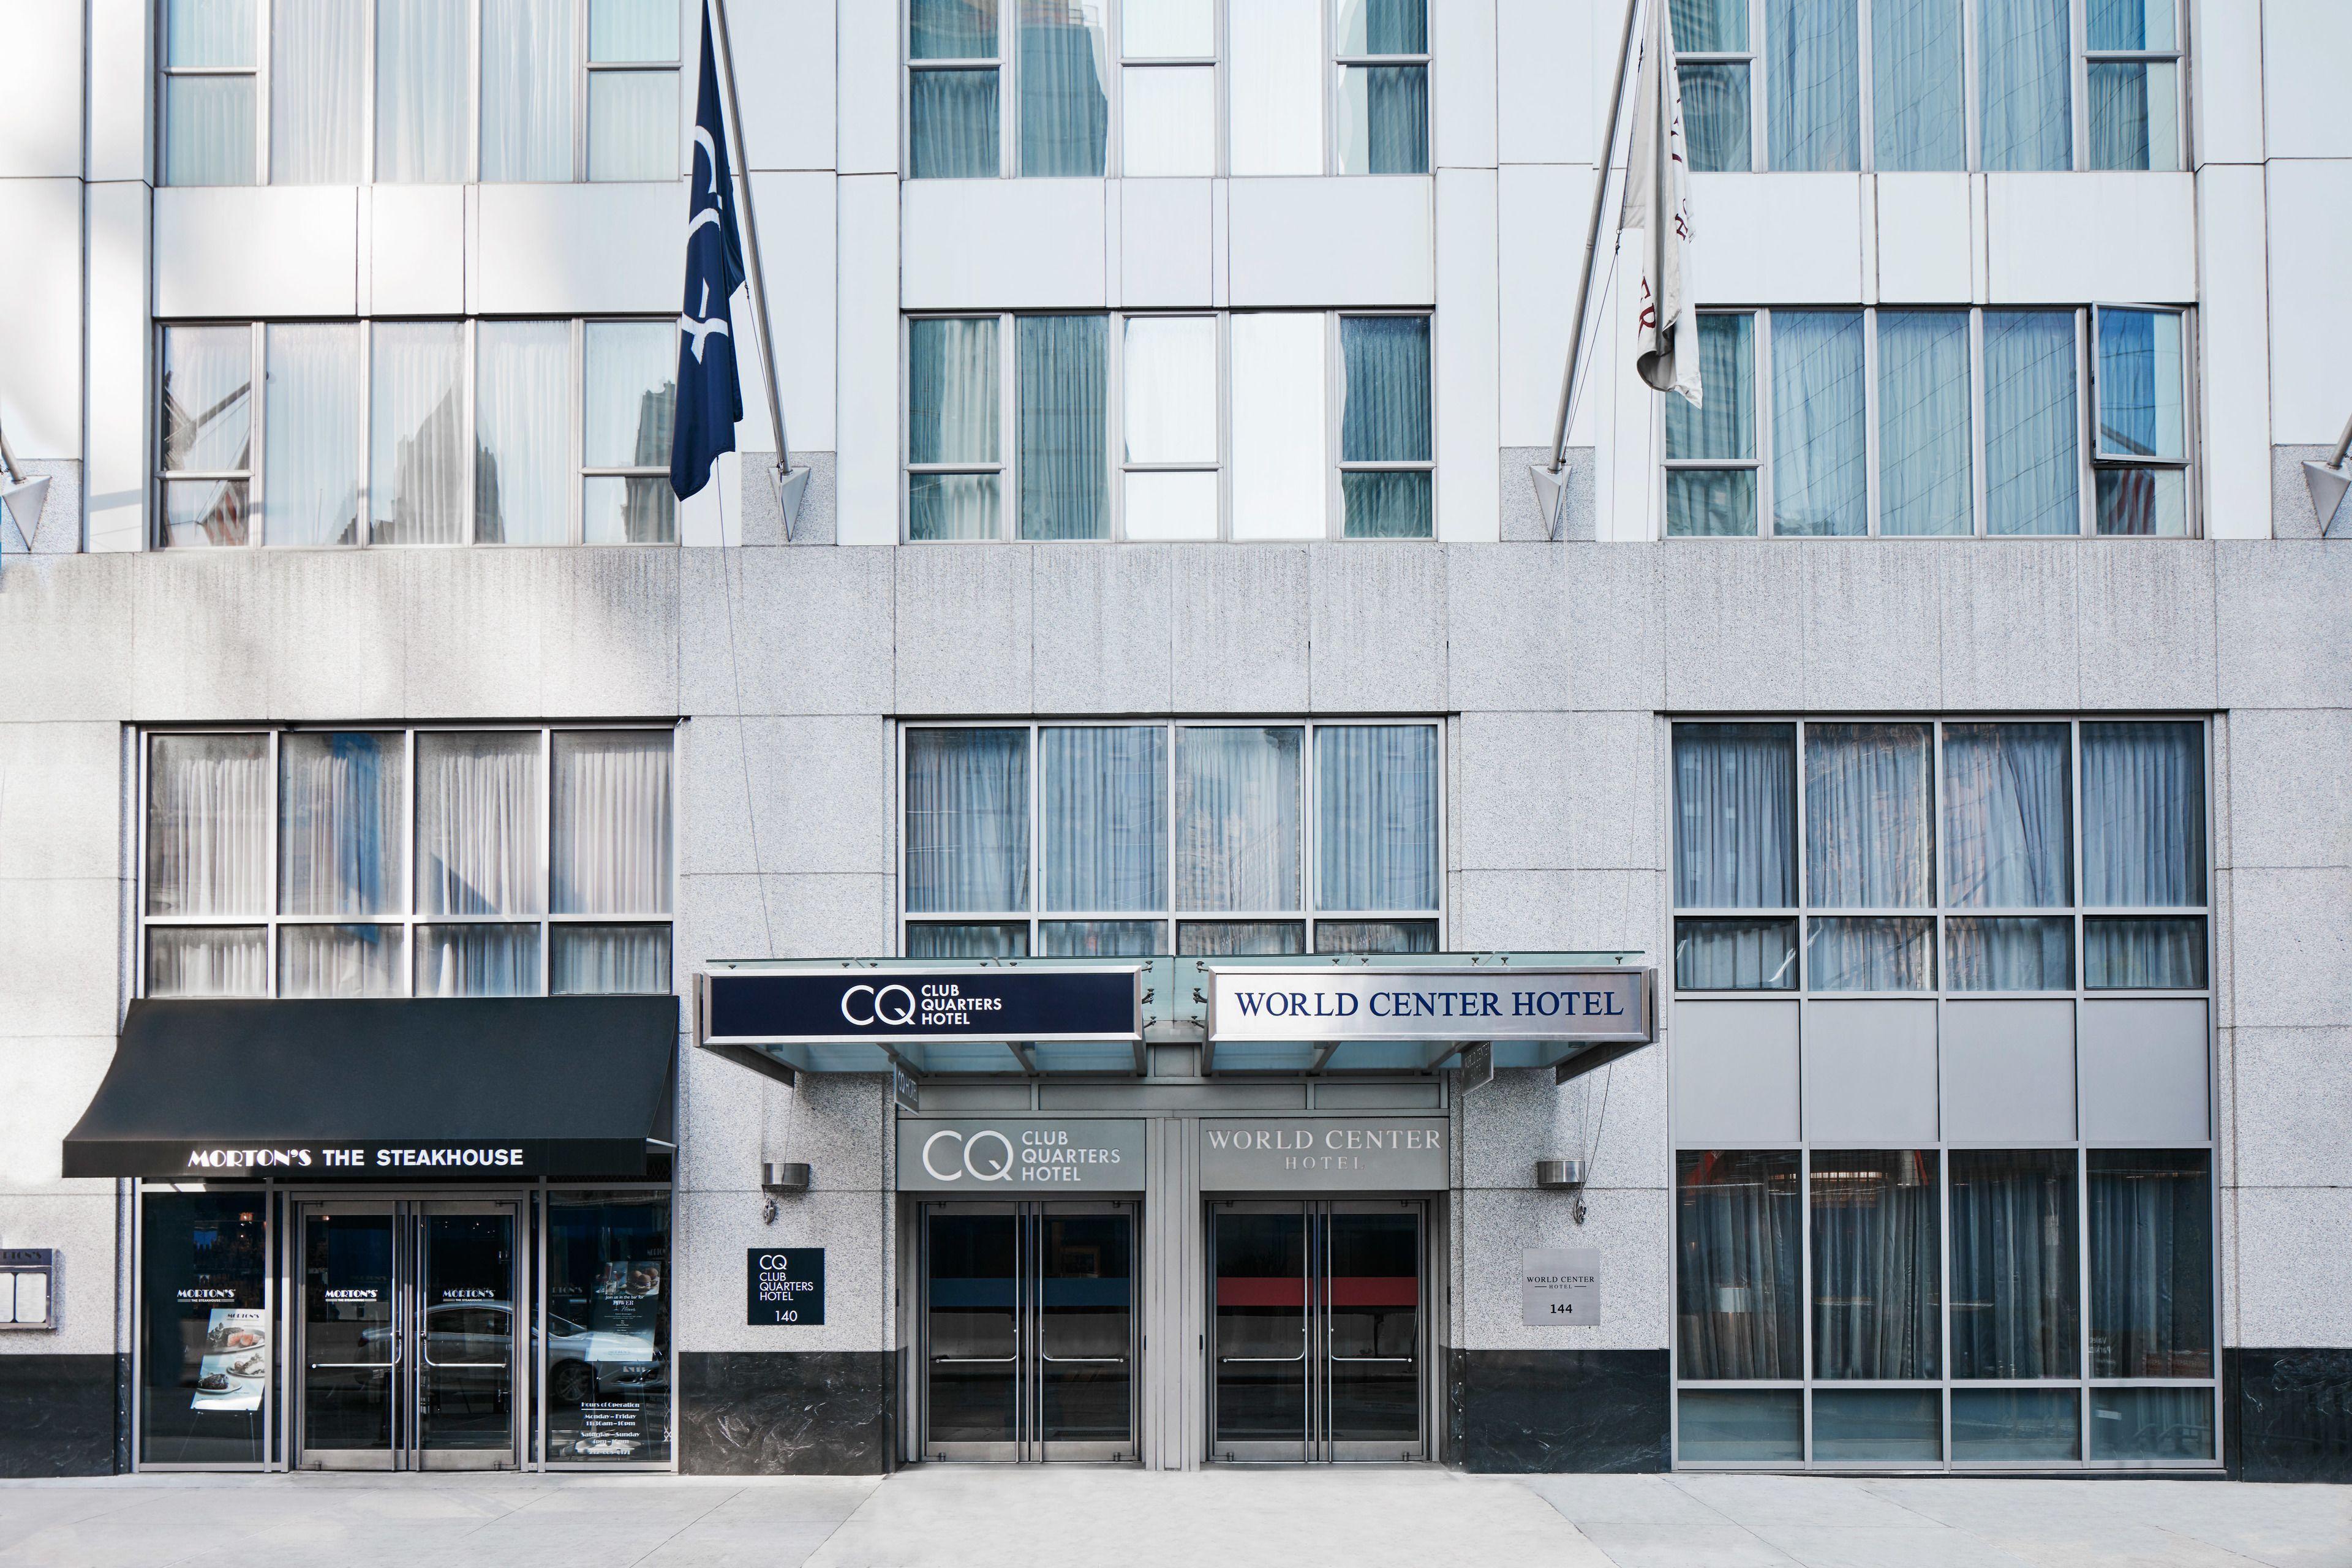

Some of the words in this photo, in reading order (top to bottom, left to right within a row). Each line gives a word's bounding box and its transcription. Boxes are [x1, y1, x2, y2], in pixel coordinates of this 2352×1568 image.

[921, 984, 960, 997] CLUB
[841, 984, 916, 1025] CQ
[921, 998, 1002, 1011] QUARTERS
[1234, 992, 1359, 1016] WORLD
[1370, 992, 1503, 1016] CENTER
[1512, 991, 1624, 1016] HOTEL
[922, 1012, 970, 1025] HOTEL
[1022, 1131, 1068, 1145] CLUB
[1207, 1129, 1313, 1149] WORLD
[1325, 1129, 1442, 1149] CENTER
[187, 1149, 312, 1167] MORTON'S
[323, 1150, 364, 1166] THE
[376, 1149, 524, 1166] STEAKHOUSE
[922, 1130, 1014, 1181] CQ
[1022, 1148, 1121, 1164] QUARTERS
[1284, 1156, 1365, 1170] HOTEL
[1022, 1166, 1081, 1182] HOTEL
[760, 1254, 787, 1270] CQ
[760, 1272, 786, 1281] CLUB
[760, 1281, 813, 1291] QUARTERS
[760, 1292, 794, 1301] HOTEL
[775, 1310, 797, 1322] 140
[1550, 1304, 1573, 1314] 144
